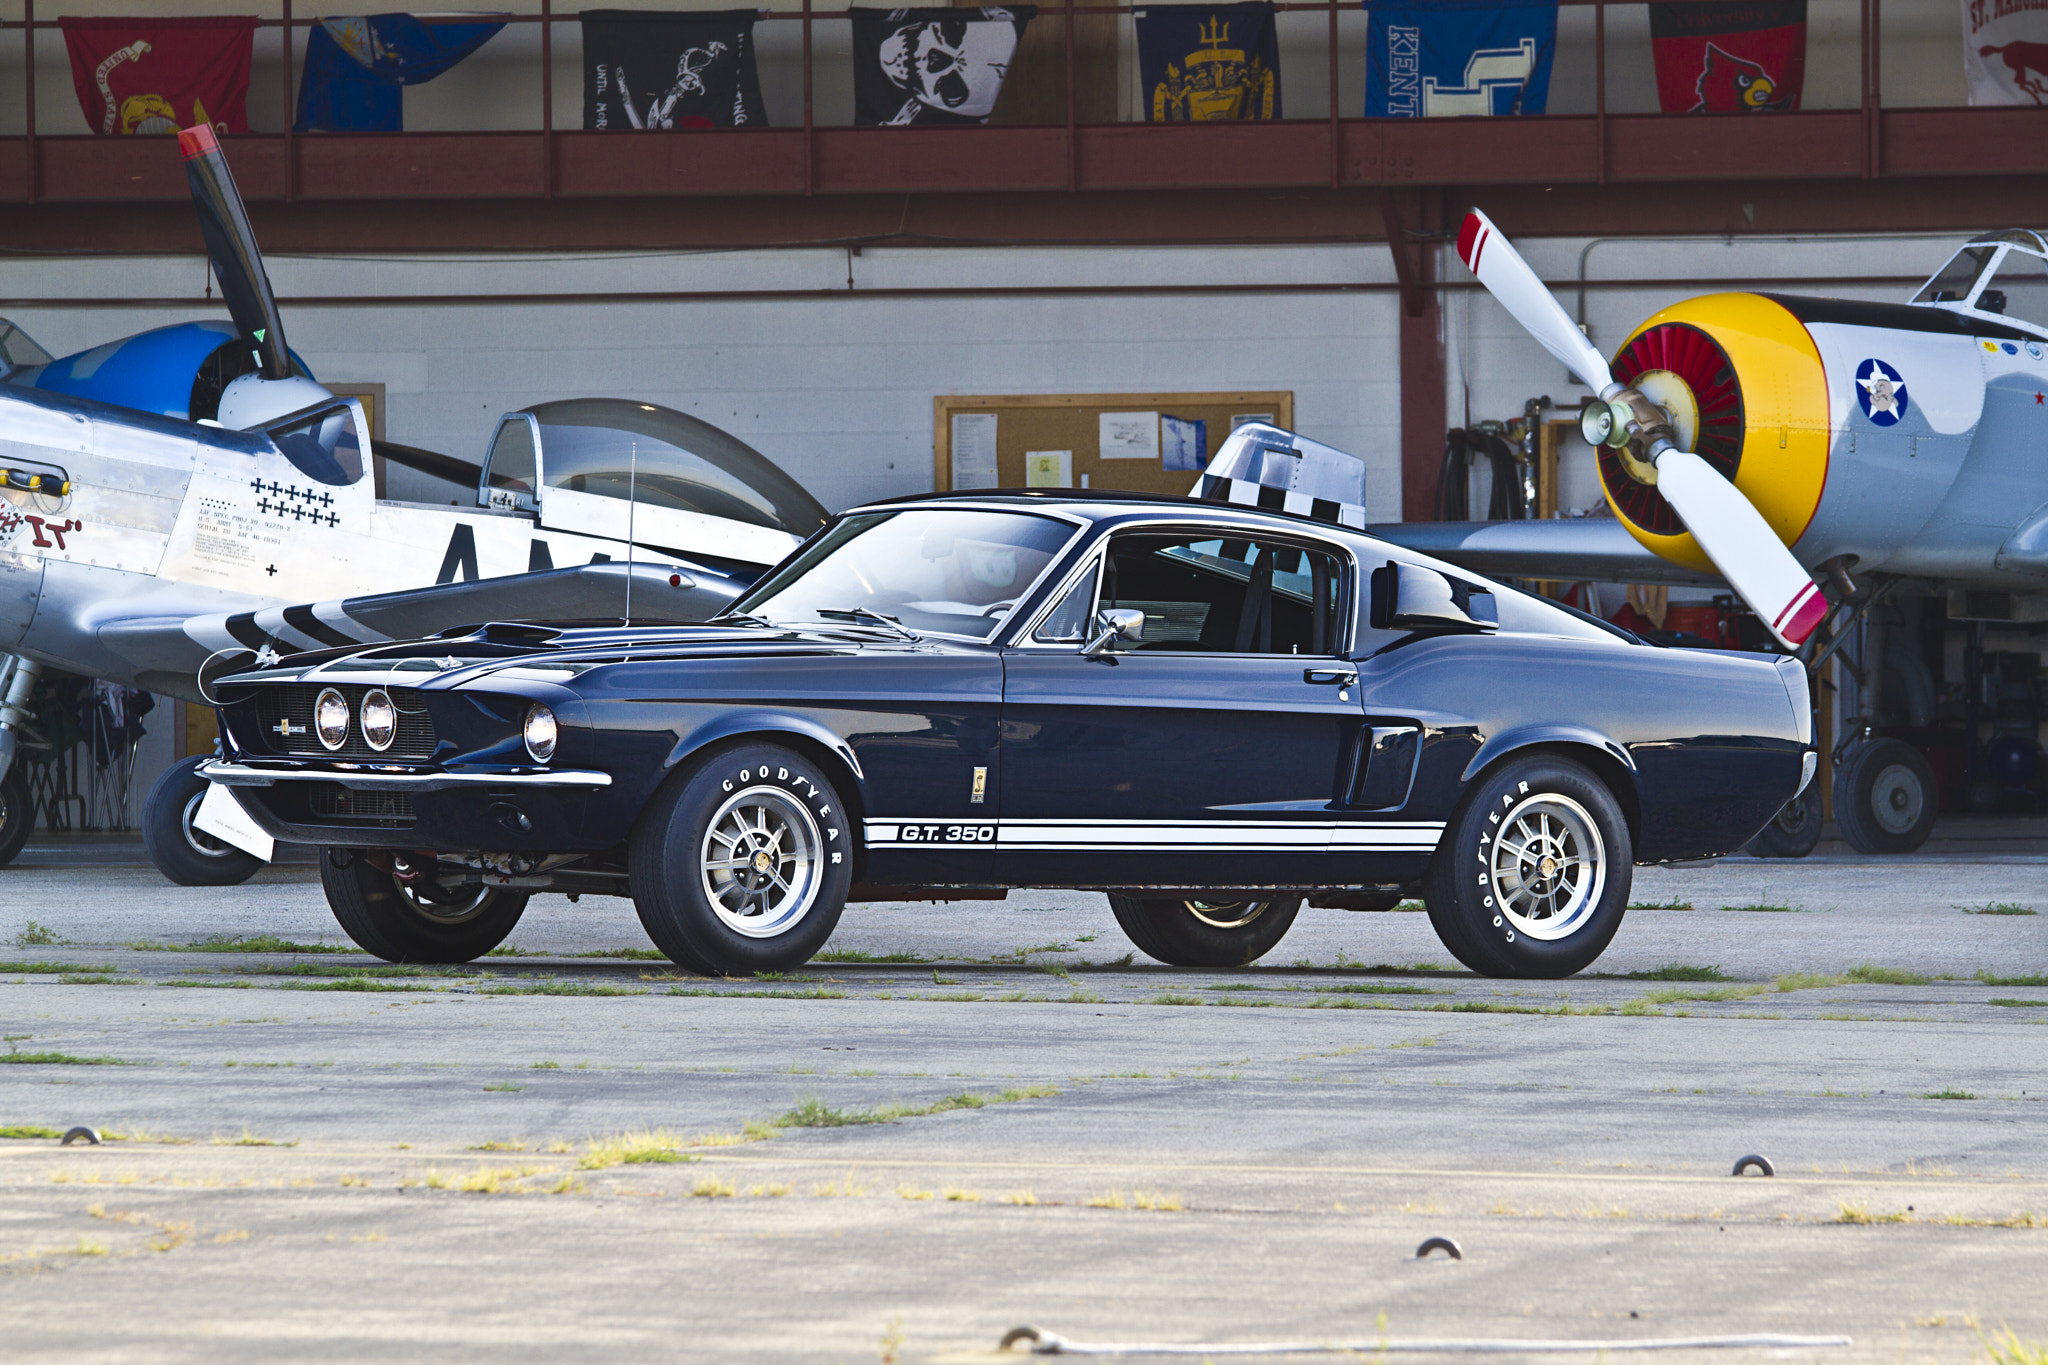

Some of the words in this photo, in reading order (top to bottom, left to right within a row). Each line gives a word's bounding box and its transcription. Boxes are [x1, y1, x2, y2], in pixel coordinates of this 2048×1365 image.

[1676, 7, 1766, 28] University
[97, 49, 129, 85] UNITED
[596, 64, 608, 95] UNTIL
[722, 764, 842, 865] GOODYEAR
[901, 825, 940, 842] G.T.
[945, 825, 995, 842] 350
[1476, 779, 1530, 944] GOODYEAR
